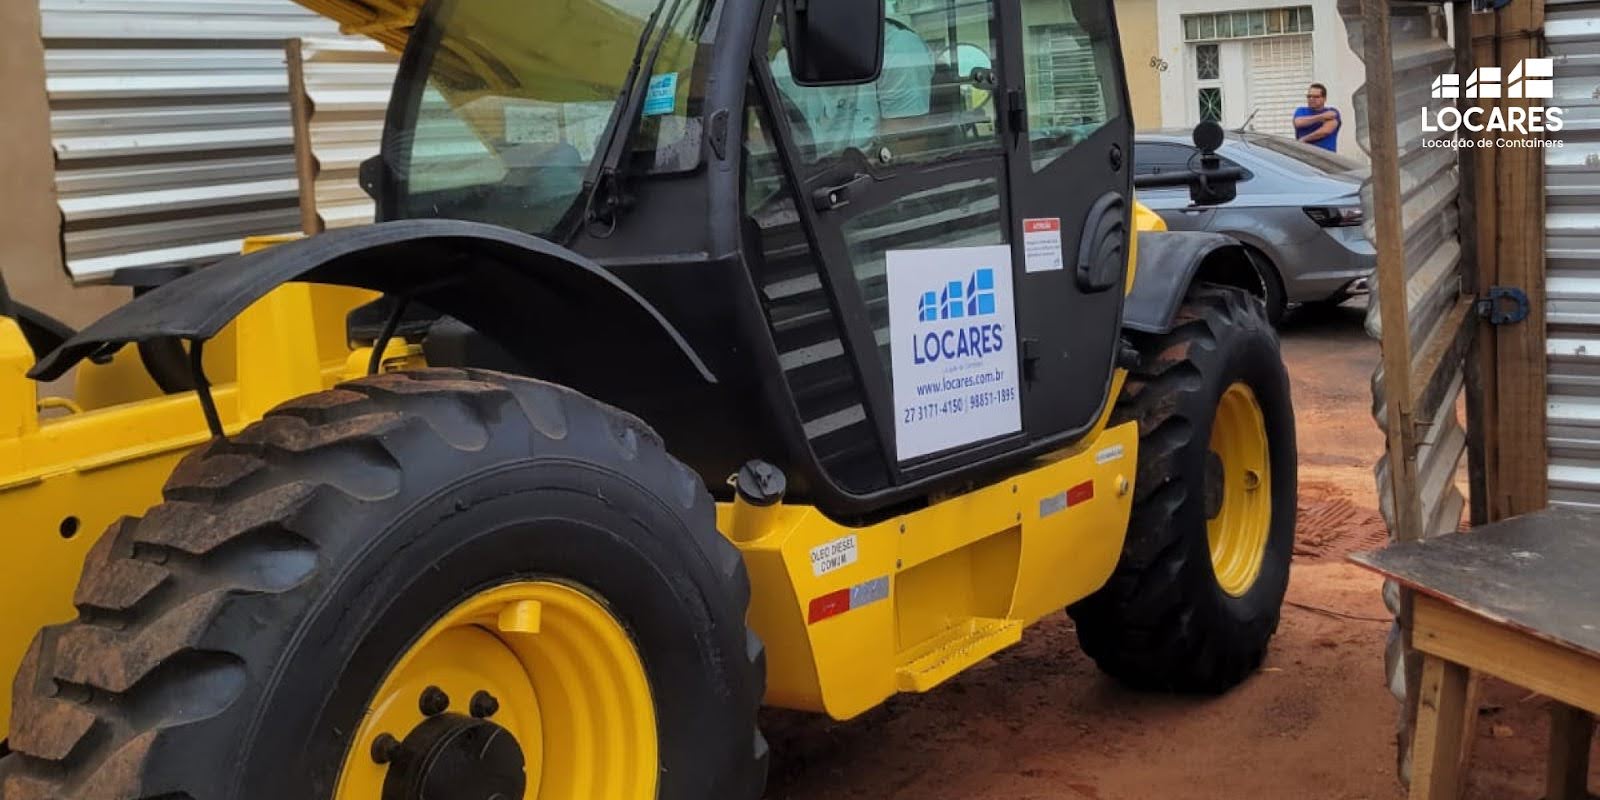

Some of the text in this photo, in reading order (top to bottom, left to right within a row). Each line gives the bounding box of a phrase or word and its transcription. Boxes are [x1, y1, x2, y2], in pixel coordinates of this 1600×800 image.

[1150, 56, 1168, 71] 879
[913, 323, 1003, 365] LOCARES
[917, 368, 1004, 396] www.locares.com.br
[904, 408, 915, 424] 27
[918, 398, 963, 421] 3171-4150
[832, 537, 854, 555] DIESEL
